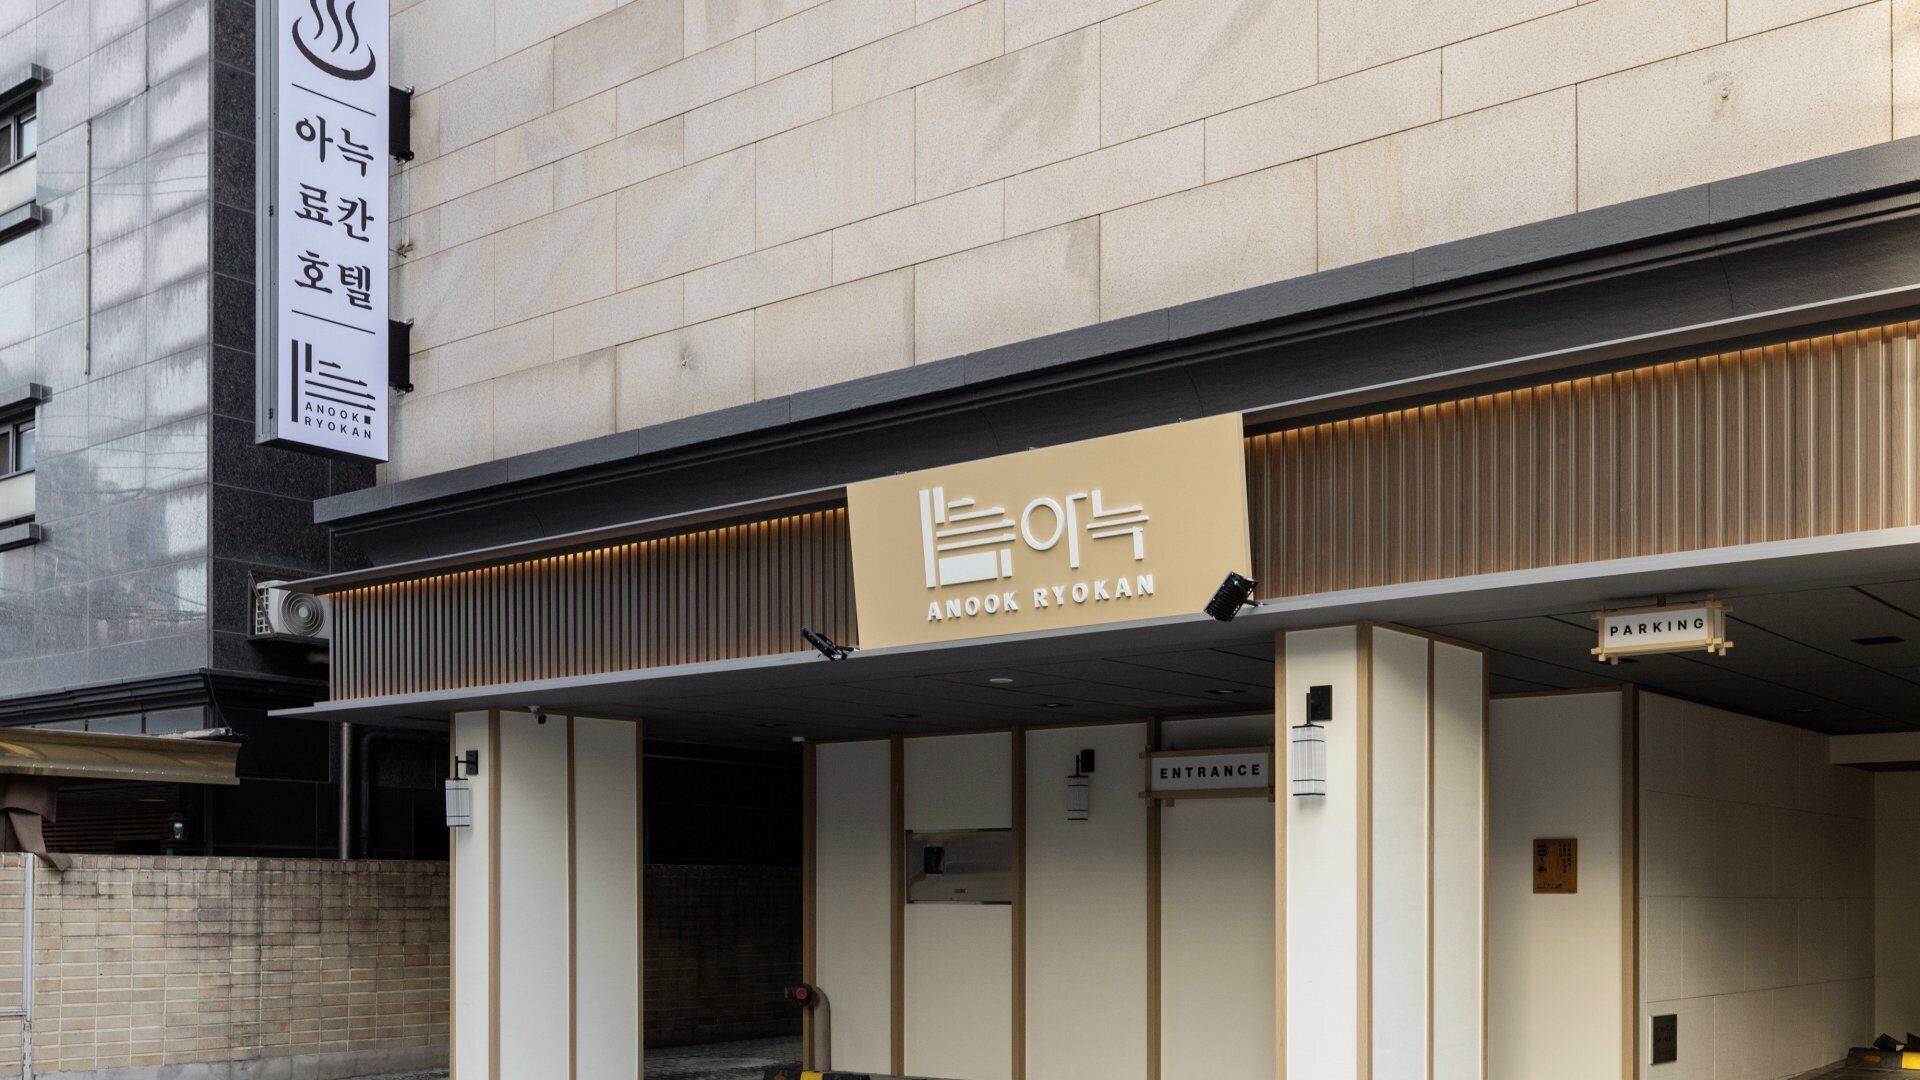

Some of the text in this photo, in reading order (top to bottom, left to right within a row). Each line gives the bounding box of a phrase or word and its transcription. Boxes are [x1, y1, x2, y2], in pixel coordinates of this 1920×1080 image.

[295, 115, 374, 177] 아늑
[294, 182, 374, 242] 료칸
[294, 250, 372, 310] 호텔
[304, 416, 371, 439] RYOKAN
[305, 401, 359, 422] ANOOK
[928, 573, 1155, 621] ANOOK RYOKAN
[1610, 618, 1704, 636] PARKING
[1160, 764, 1260, 779] ENTRANCE
